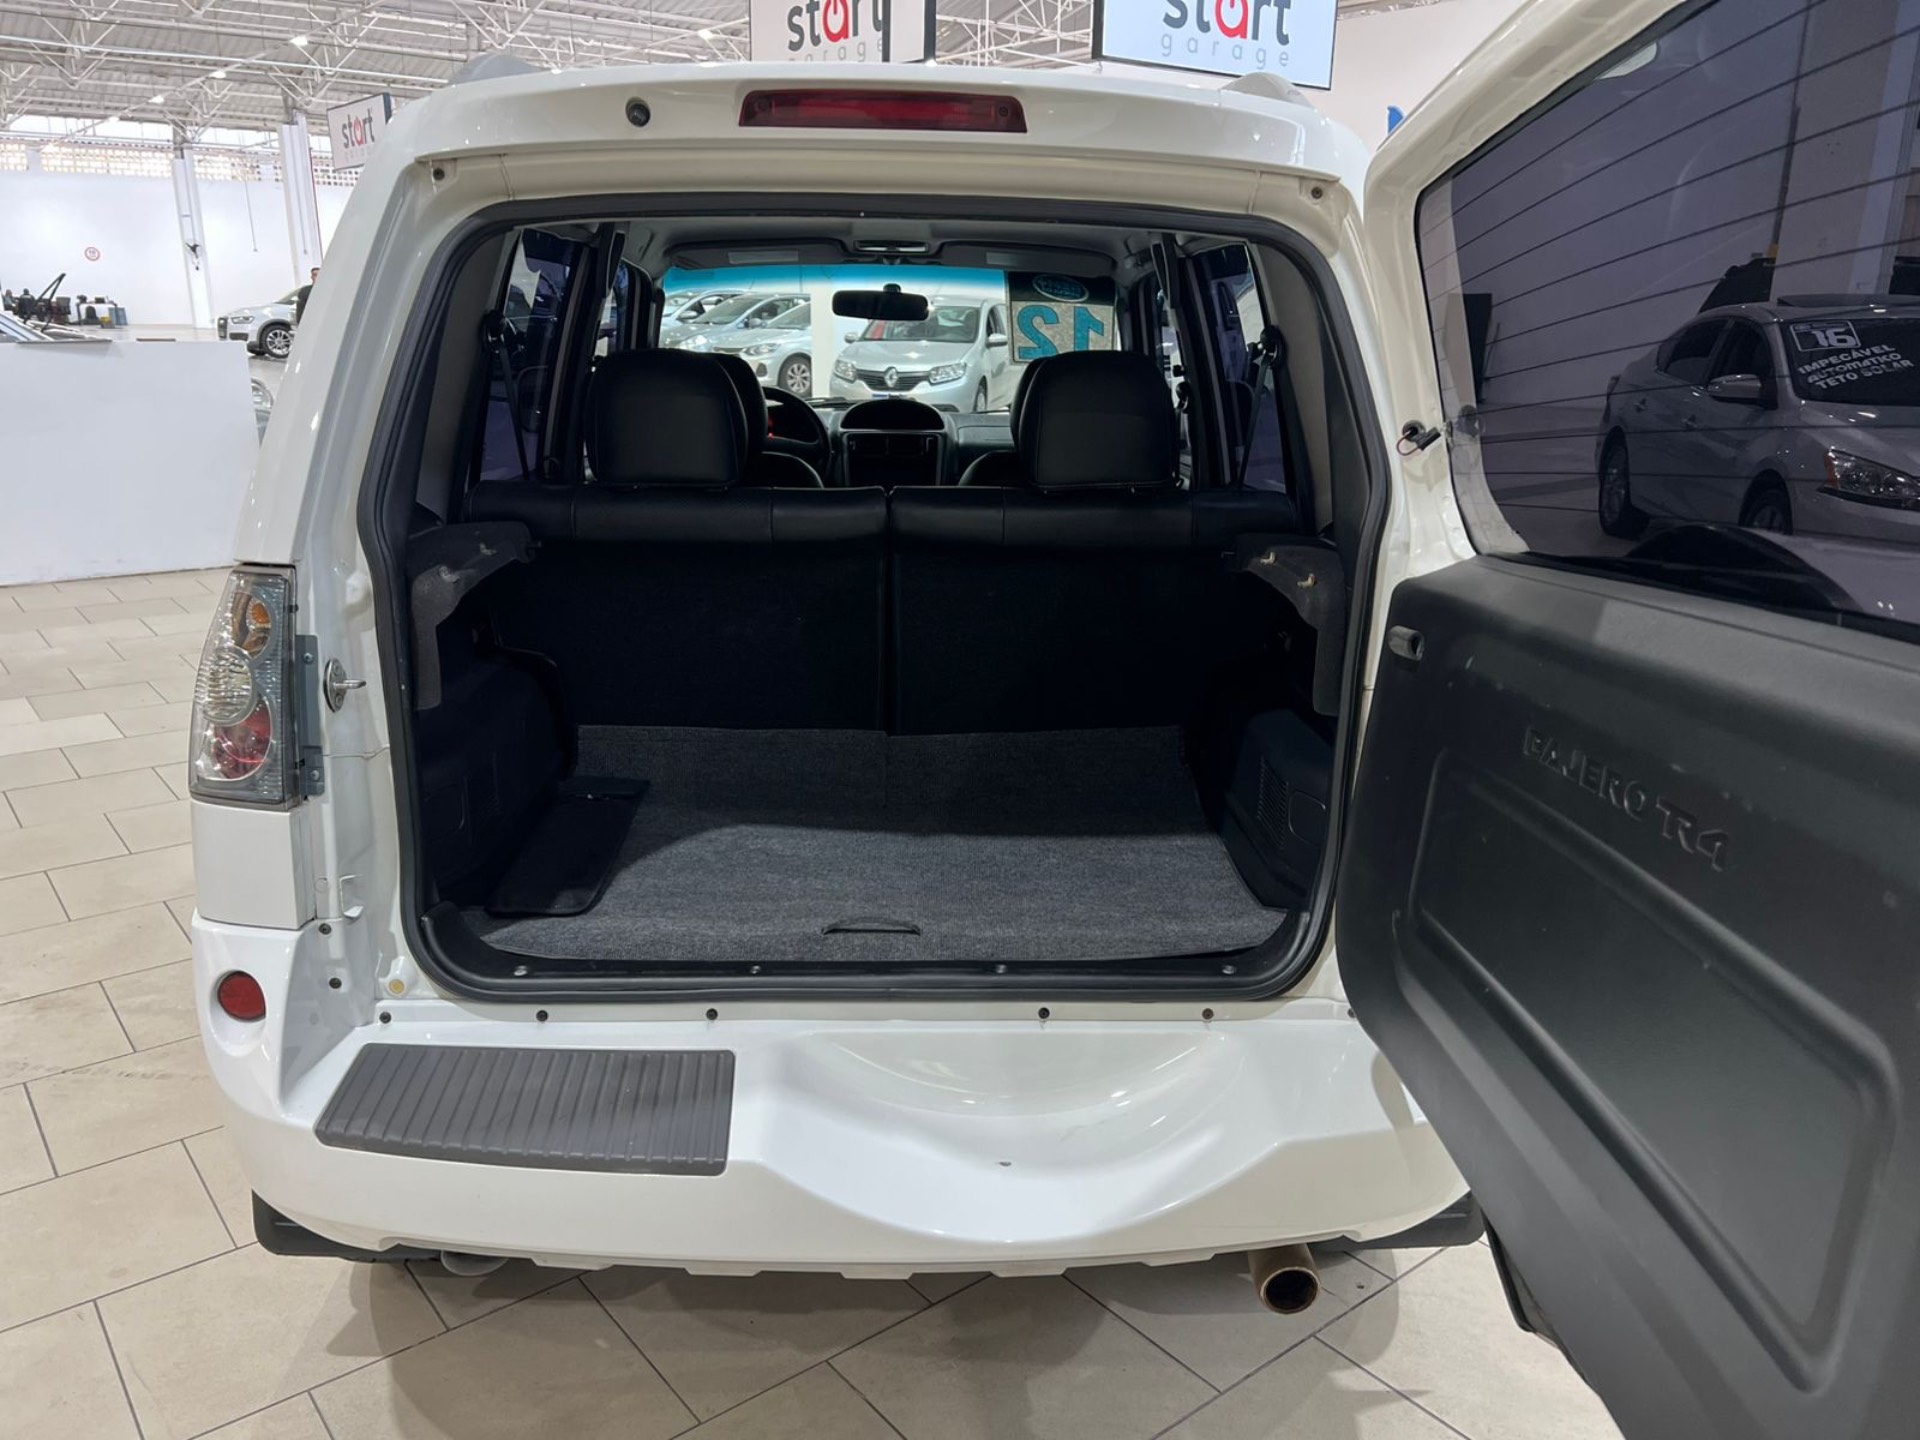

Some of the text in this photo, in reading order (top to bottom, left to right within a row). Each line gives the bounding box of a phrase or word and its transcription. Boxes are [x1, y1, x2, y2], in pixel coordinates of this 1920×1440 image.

[1161, 33, 1289, 70] garage
[342, 107, 375, 149] start
[1811, 328, 1857, 348] 16
[1815, 359, 1915, 389] TETO SOLAR
